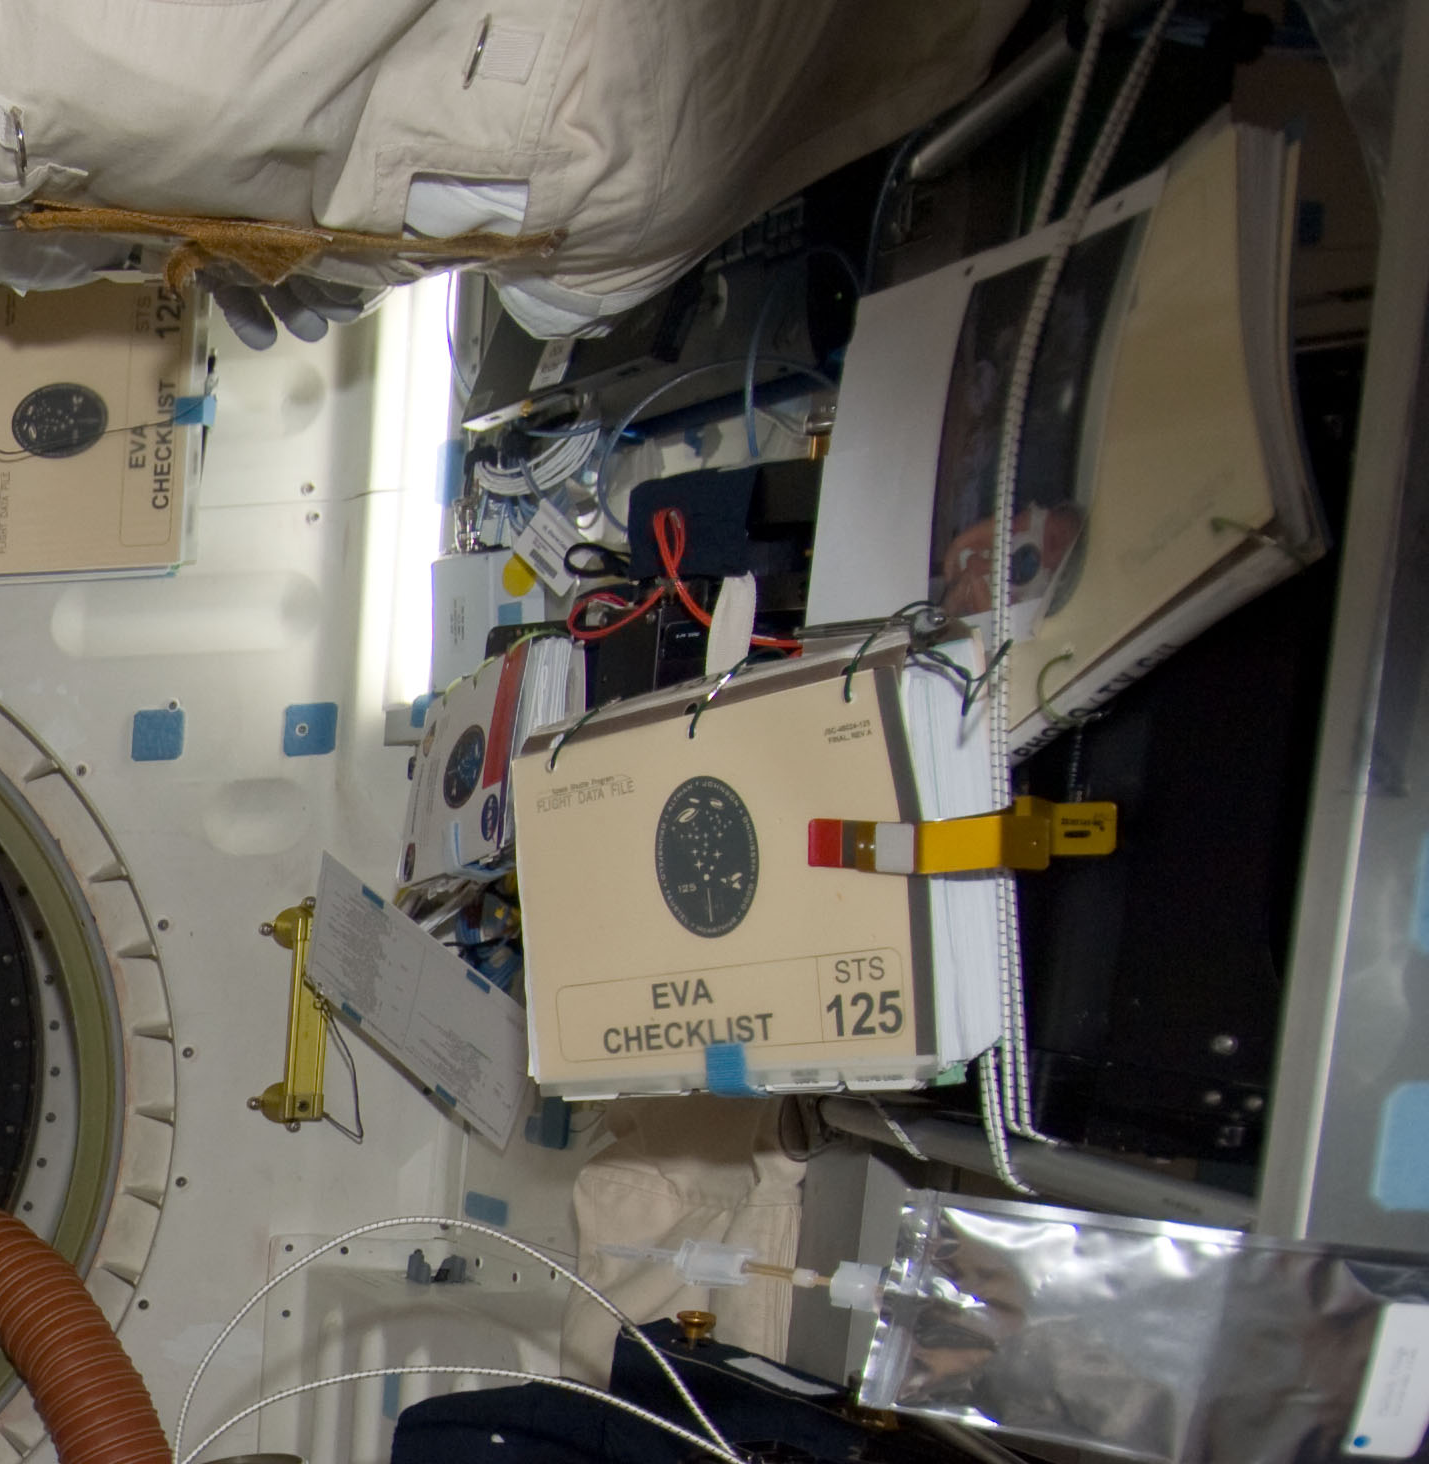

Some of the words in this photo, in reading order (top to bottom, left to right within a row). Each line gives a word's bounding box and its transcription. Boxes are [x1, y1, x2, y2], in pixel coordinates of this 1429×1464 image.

[135, 295, 153, 333] STS
[129, 426, 148, 470] EVA
[152, 378, 176, 510] CHECKLIST
[536, 795, 572, 813] FLIGHT
[578, 788, 604, 805] DATA
[611, 780, 635, 796] FILE
[651, 978, 714, 1010] EVA
[834, 956, 886, 984] STS
[603, 1012, 773, 1055] CHECKLIST
[826, 989, 905, 1038] 125
